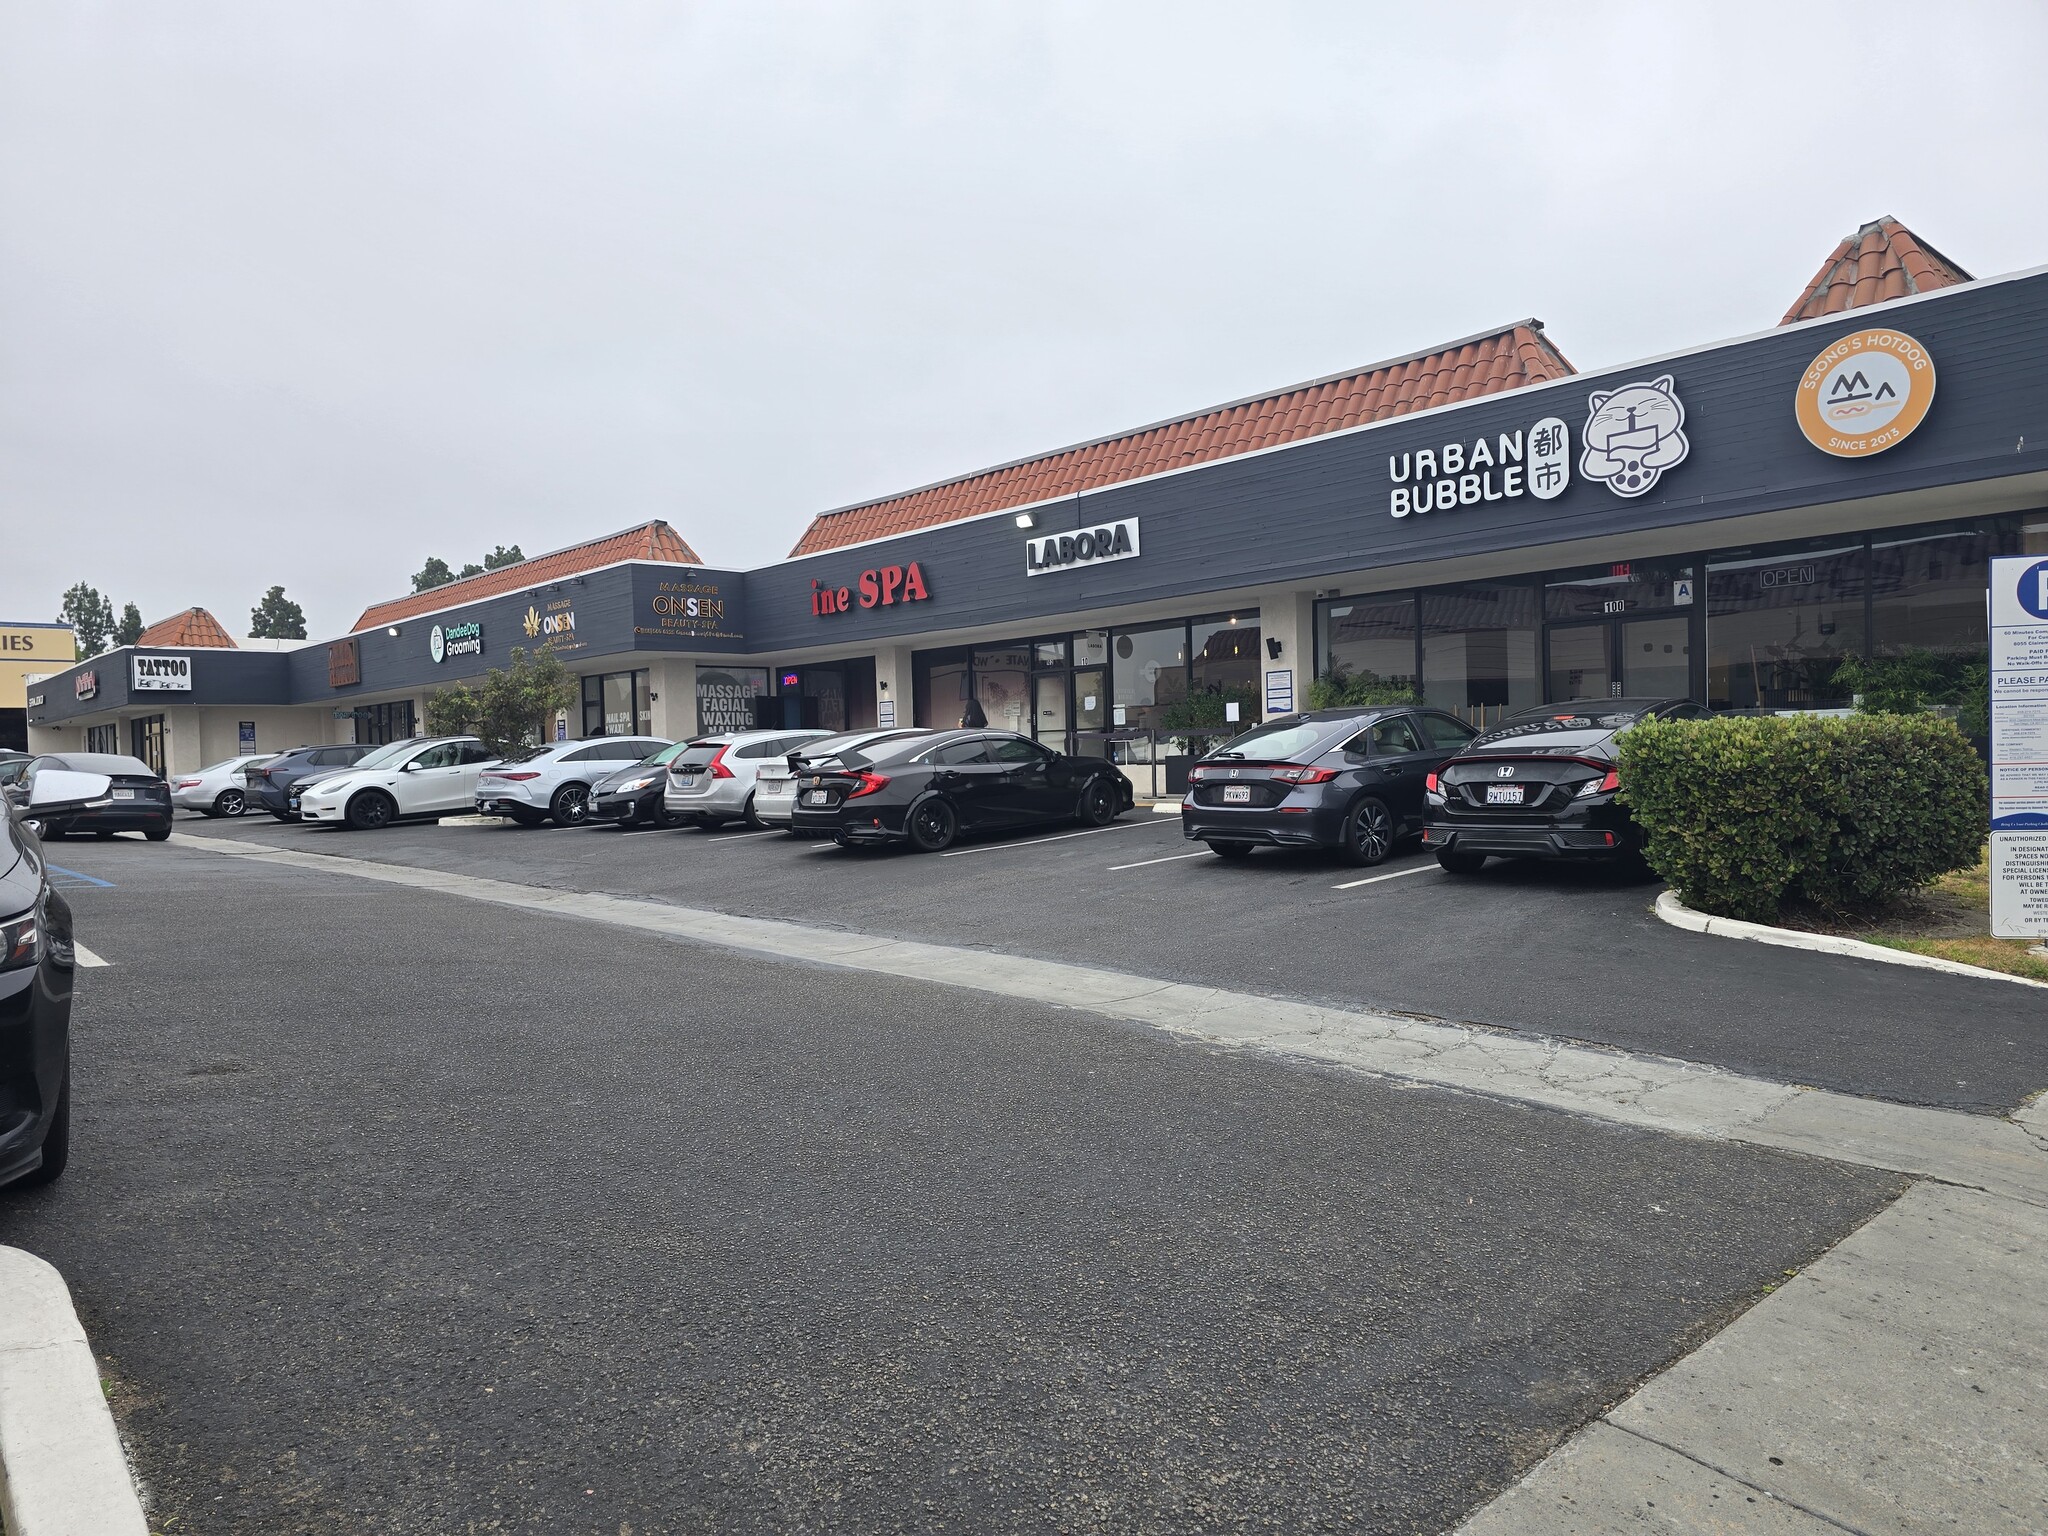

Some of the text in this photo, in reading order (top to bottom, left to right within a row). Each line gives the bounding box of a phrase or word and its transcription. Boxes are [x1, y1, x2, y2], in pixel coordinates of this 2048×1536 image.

[1804, 335, 1926, 389] SSONG'S HOTDOG
[1828, 427, 1900, 450] SINCE 2013
[1389, 429, 1523, 483] URBAN
[1533, 424, 1563, 491] 都市
[1390, 465, 1524, 518] BUBBLE
[1028, 524, 1132, 570] LABORA
[1763, 567, 1812, 586] OPEN
[660, 582, 719, 595] MASSAGE
[811, 561, 928, 616] ine SPA
[1678, 584, 1690, 596] A
[547, 599, 572, 612] MASSAGE
[652, 595, 724, 620] ONSEN
[1605, 600, 1624, 613] 100
[446, 622, 480, 640] DandeeDog
[543, 611, 576, 635] ONSEN
[661, 618, 718, 630] BEAUTY-SPA
[0, 635, 34, 651] IES
[446, 636, 481, 656] Grooming
[138, 659, 187, 676] TATTOO
[783, 675, 798, 686] OPEN
[1997, 676, 2036, 685] PLEASE
[697, 684, 757, 699] MASSAGE
[703, 698, 749, 712] FACIAL
[620, 711, 630, 722] SPA
[702, 712, 753, 726] WAXING
